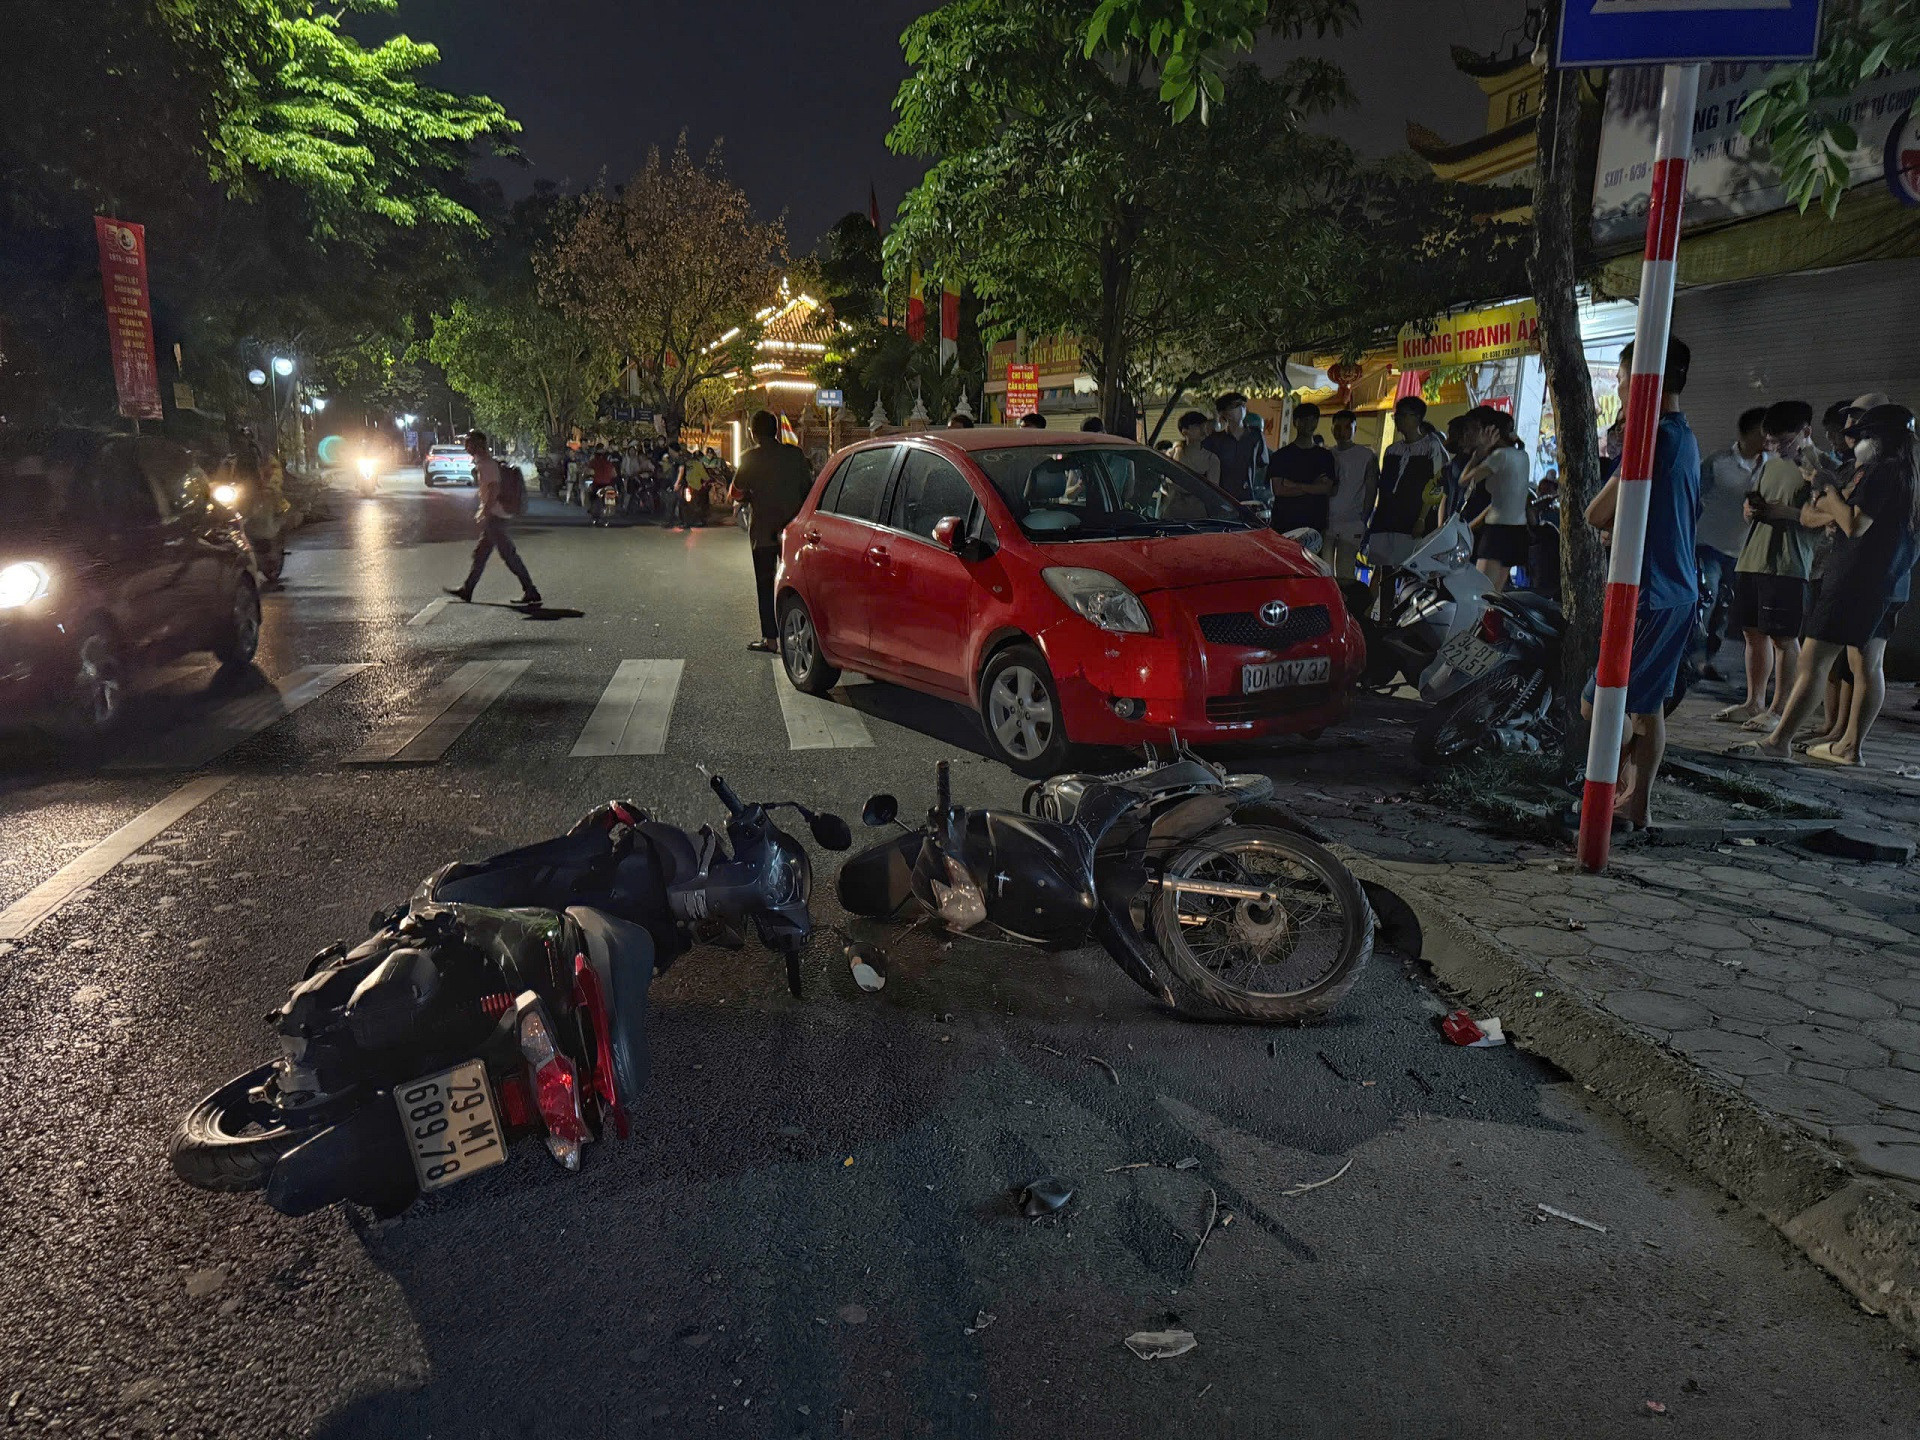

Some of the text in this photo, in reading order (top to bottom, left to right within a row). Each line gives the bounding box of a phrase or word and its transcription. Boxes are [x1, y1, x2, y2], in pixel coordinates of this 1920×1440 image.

[1403, 333, 1453, 359] KHUNG
[1457, 322, 1511, 351] TRANH
[1516, 312, 1538, 341] ẢN
[404, 1083, 461, 1181] 689.78
[446, 1077, 498, 1157] 29-M1
